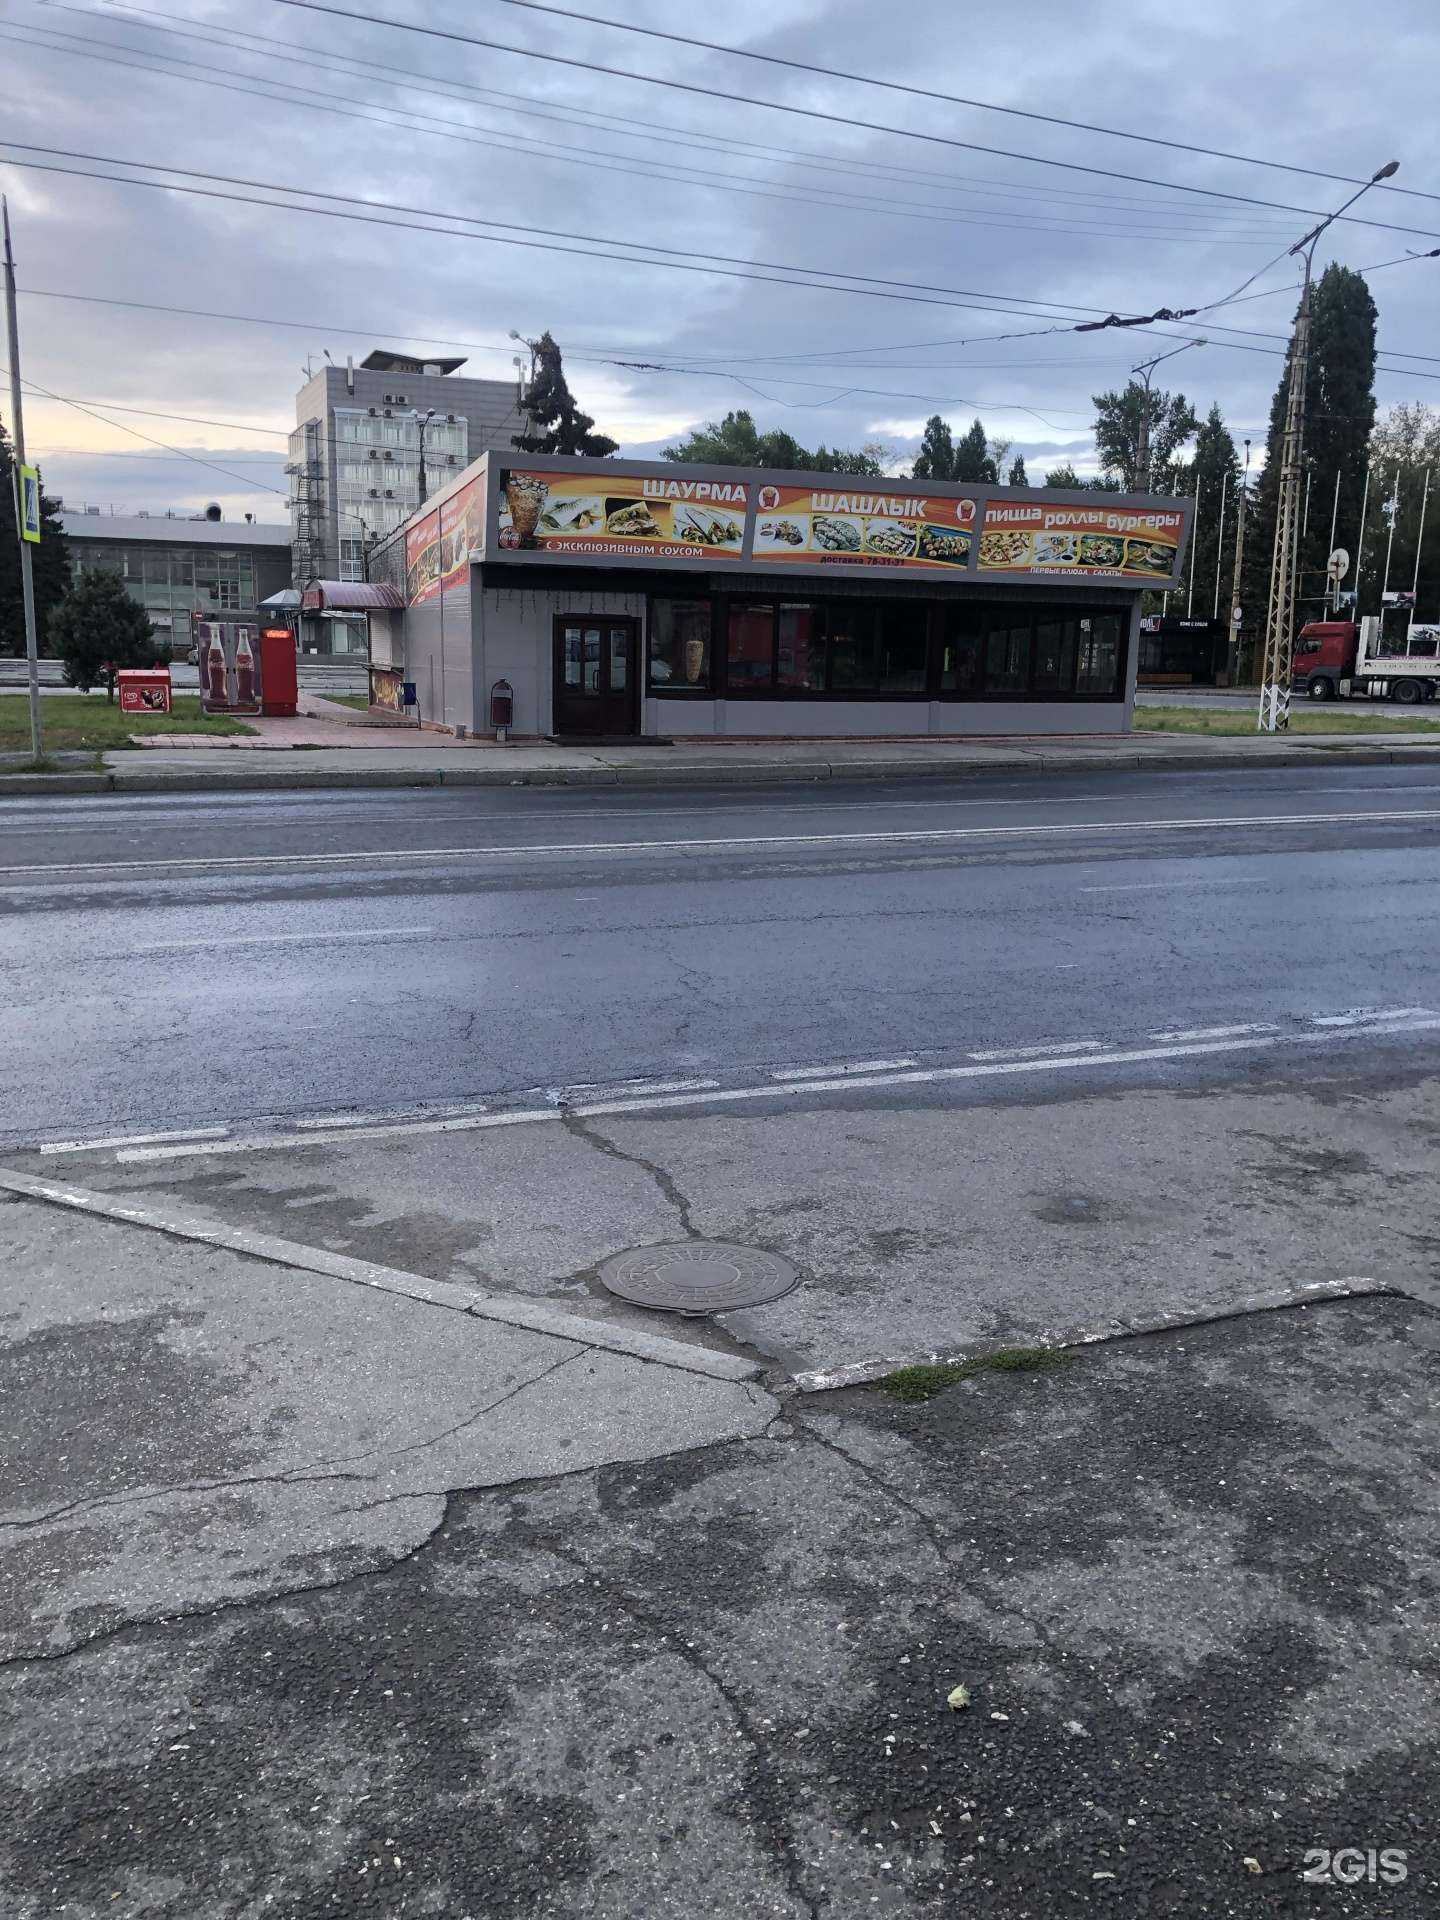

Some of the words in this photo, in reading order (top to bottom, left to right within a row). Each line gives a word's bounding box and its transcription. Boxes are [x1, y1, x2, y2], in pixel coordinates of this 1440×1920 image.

[643, 480, 747, 502] ШАУРМА
[811, 493, 928, 517] ШАШЛЫК
[985, 508, 1042, 523] пицца
[1044, 511, 1104, 529] роллы
[1106, 513, 1181, 532] бургеры
[556, 541, 655, 555] ЭКСКЛЮЗИВНЫМ
[659, 546, 703, 556] СОУСОМ
[1030, 566, 1060, 575] ПЕРВЫЕ
[1061, 567, 1088, 576] БЛЮДА
[1093, 569, 1123, 577] САЛАТЫ
